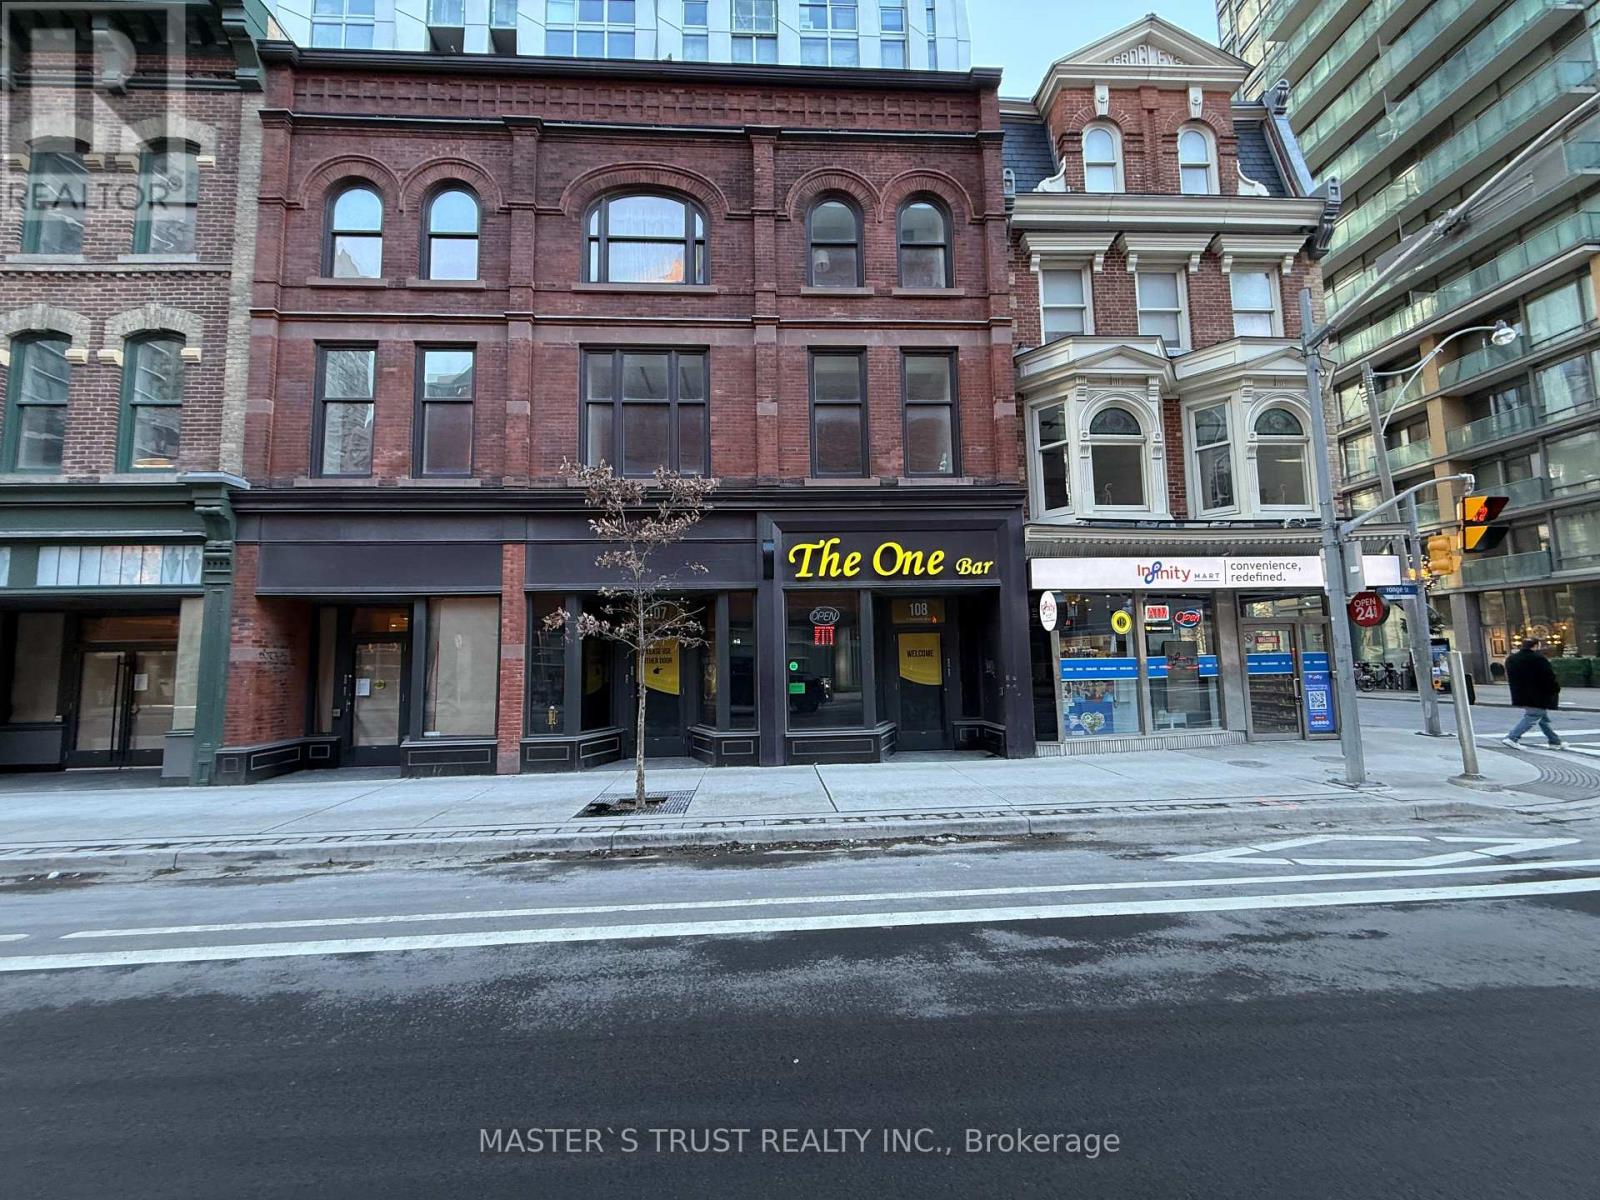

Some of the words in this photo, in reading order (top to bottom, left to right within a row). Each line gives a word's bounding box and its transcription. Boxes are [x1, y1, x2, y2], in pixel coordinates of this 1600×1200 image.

[788, 537, 862, 578] The
[872, 541, 945, 576] One
[955, 557, 994, 575] Bar
[1230, 560, 1302, 572] convenience,
[1194, 572, 1220, 580] MART
[1231, 571, 1287, 582] redefined.
[1354, 596, 1376, 607] OPEN
[909, 602, 928, 617] 108
[1355, 605, 1375, 620] 24
[812, 611, 837, 620] OPEN
[1175, 611, 1200, 625] Open
[906, 649, 935, 658] WELCOME
